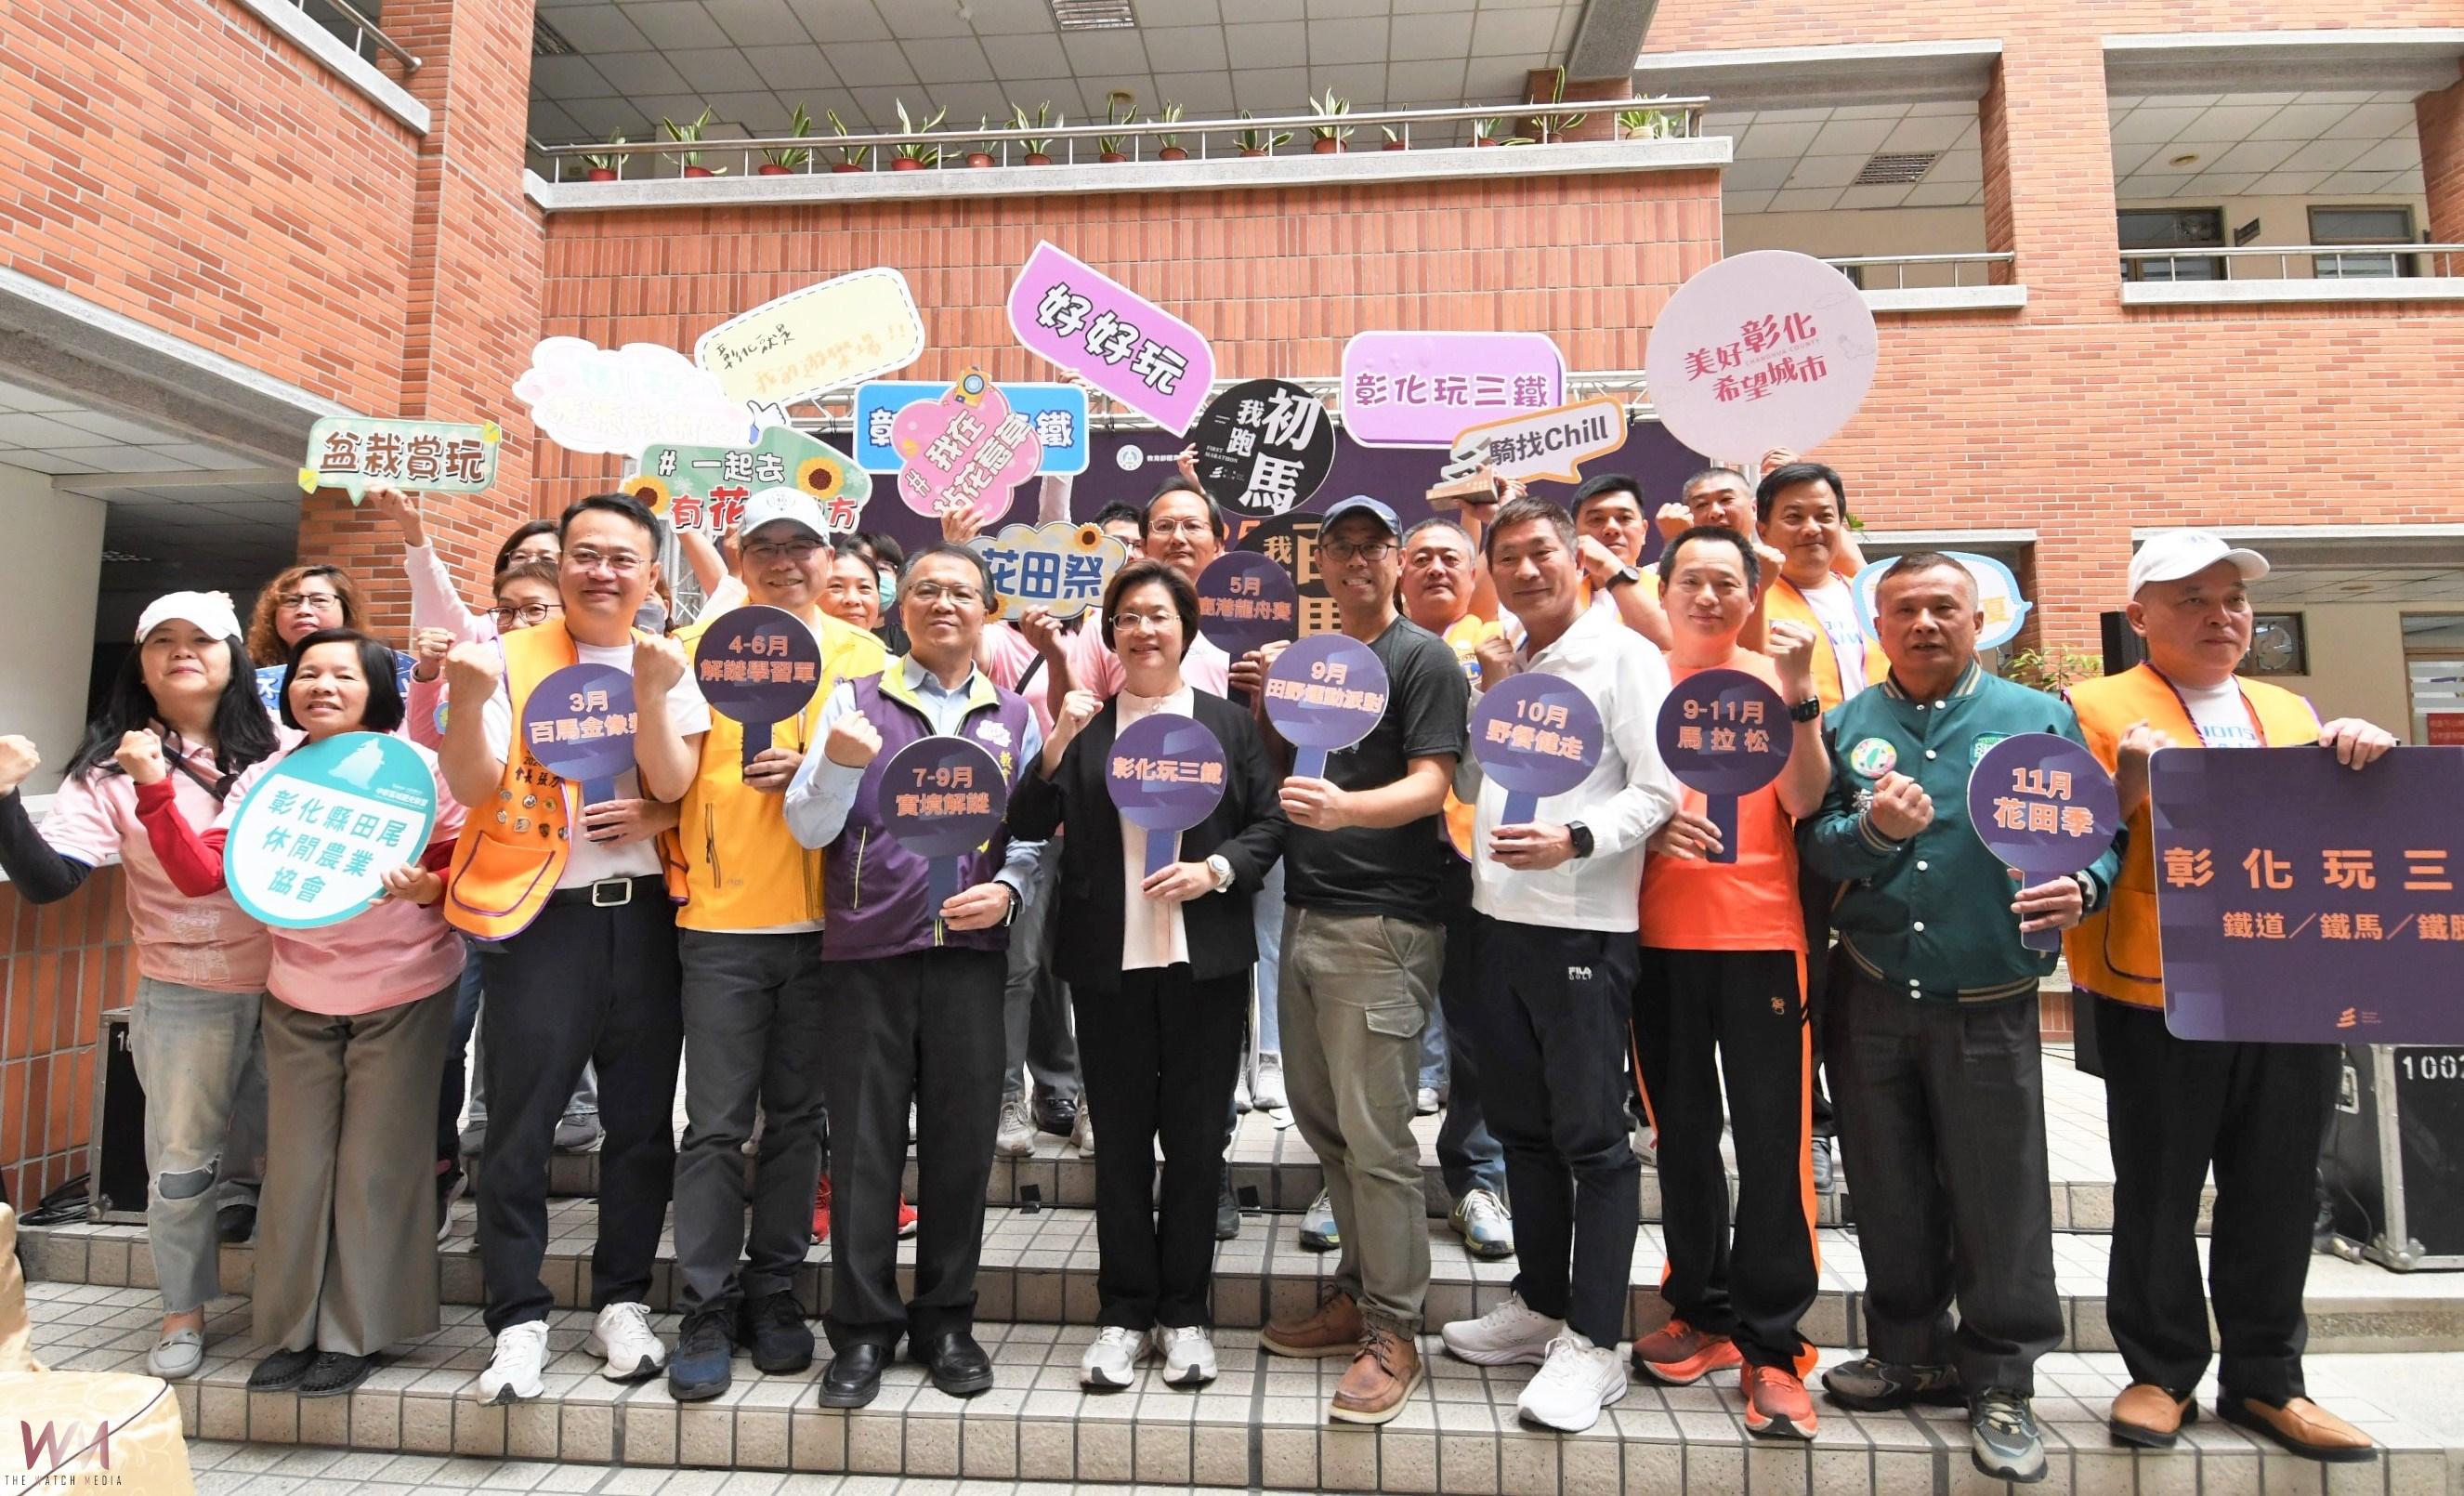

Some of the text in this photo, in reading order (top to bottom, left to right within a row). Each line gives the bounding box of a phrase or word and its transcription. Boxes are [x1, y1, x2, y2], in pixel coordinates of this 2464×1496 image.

[716, 323, 795, 370] 彰化就是
[1036, 282, 1188, 396] 好好玩
[1684, 312, 1817, 381] 美好彰化
[1788, 337, 1821, 352] COUNTY
[1354, 373, 1548, 407] 彰化玩三鐵
[1712, 355, 1828, 402] 希望城市
[924, 409, 986, 472] 我在
[1226, 399, 1265, 458] 我跑
[1488, 415, 1608, 466] 騎找Chill
[320, 431, 485, 483] 盆栽賞玩
[691, 451, 786, 483] 一起去
[1239, 387, 1322, 515] 初馬
[669, 485, 859, 531] 有花方
[982, 548, 1103, 599] 花田祭
[1229, 576, 1261, 596] 5月
[728, 635, 788, 657] 4-6月
[700, 659, 816, 683] 解謎學習單
[1310, 661, 1347, 685] 9月
[570, 690, 609, 713] 3月
[1265, 678, 1384, 714] 田野運動派對
[1516, 699, 1568, 728] 10月
[1683, 699, 1764, 724] 9-11月
[1486, 718, 1583, 761] 野餐健走
[1677, 726, 1769, 753] 馬拉松
[911, 766, 973, 788] 7-9月
[1112, 756, 1223, 784] 彰化玩三鐵
[2012, 767, 2072, 800] 11月
[268, 790, 408, 847] 彰化縣田尾
[896, 792, 990, 817] 實境解謎
[1992, 797, 2095, 837] 花田季
[262, 826, 374, 877] 休閒農業
[2164, 847, 2454, 890] 彰化玩三
[268, 866, 326, 903] 協會
[1568, 966, 1592, 975] FILA
